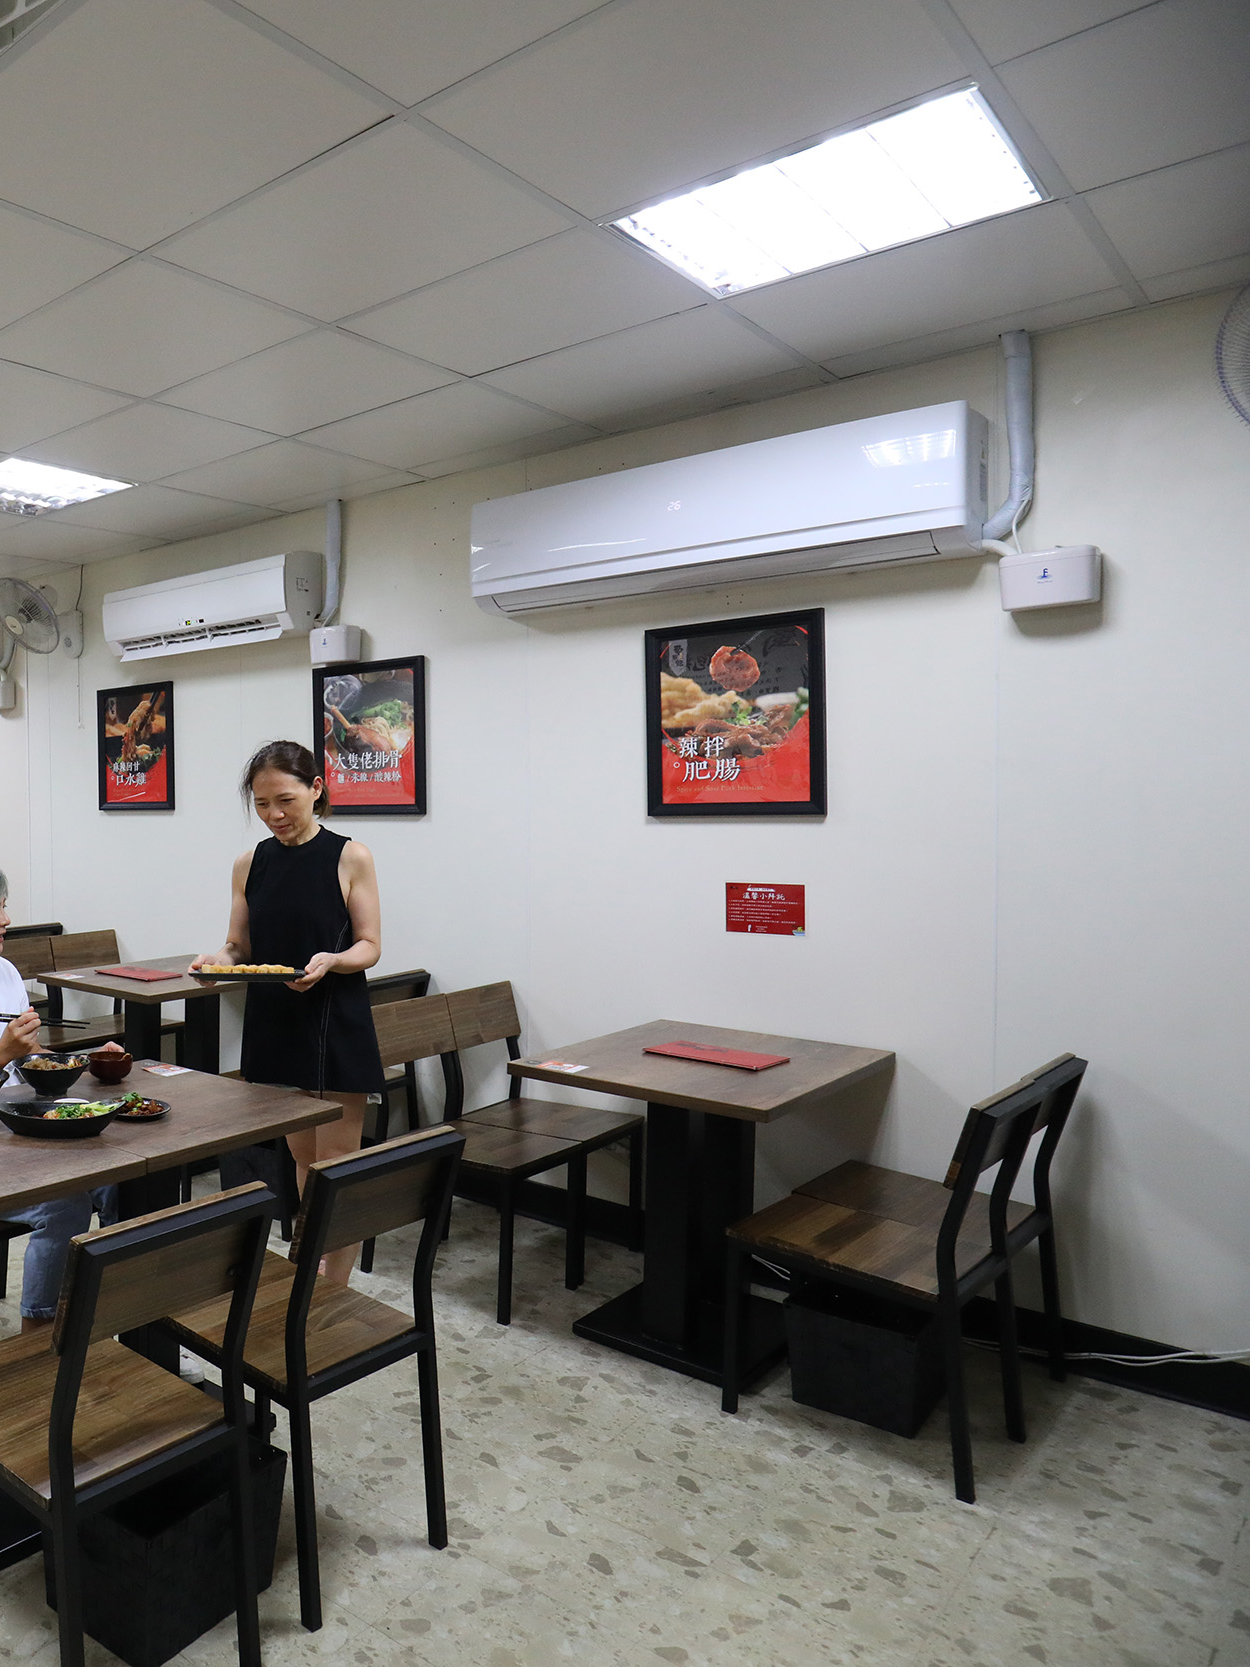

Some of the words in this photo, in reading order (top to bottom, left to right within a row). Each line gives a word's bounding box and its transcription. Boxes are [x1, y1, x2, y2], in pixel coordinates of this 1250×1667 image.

[679, 735, 725, 758] 辣拌
[333, 750, 401, 771] 大隻佬排骨
[682, 758, 741, 783] 肥腸
[116, 772, 147, 787] 口水雞
[742, 892, 785, 900] 溫馨小拜託
